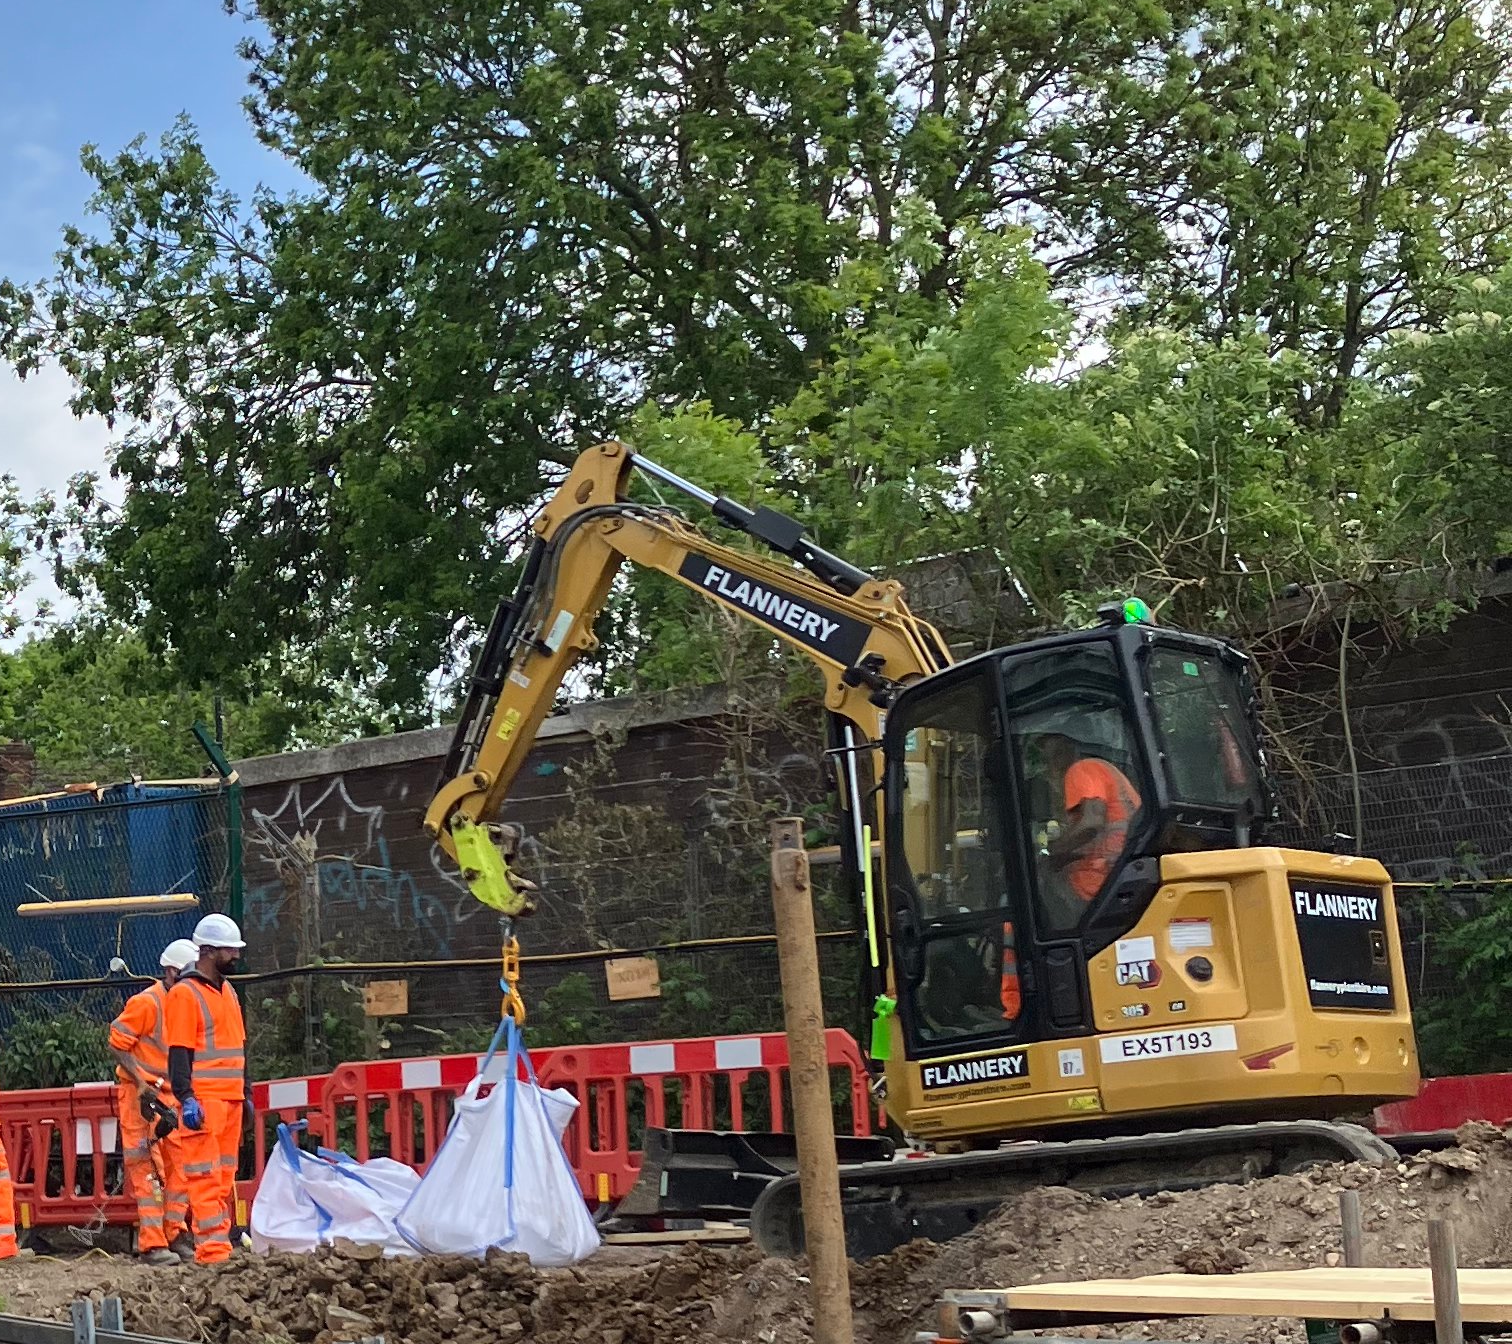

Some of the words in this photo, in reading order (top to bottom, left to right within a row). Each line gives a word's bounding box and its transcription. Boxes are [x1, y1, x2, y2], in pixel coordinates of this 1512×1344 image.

[703, 565, 840, 642] FLANNERY
[1294, 891, 1378, 921] FLANNERY
[1116, 960, 1151, 986] CAT
[1122, 1032, 1212, 1057] EX5T193
[924, 1055, 1024, 1087] FLANNERY
